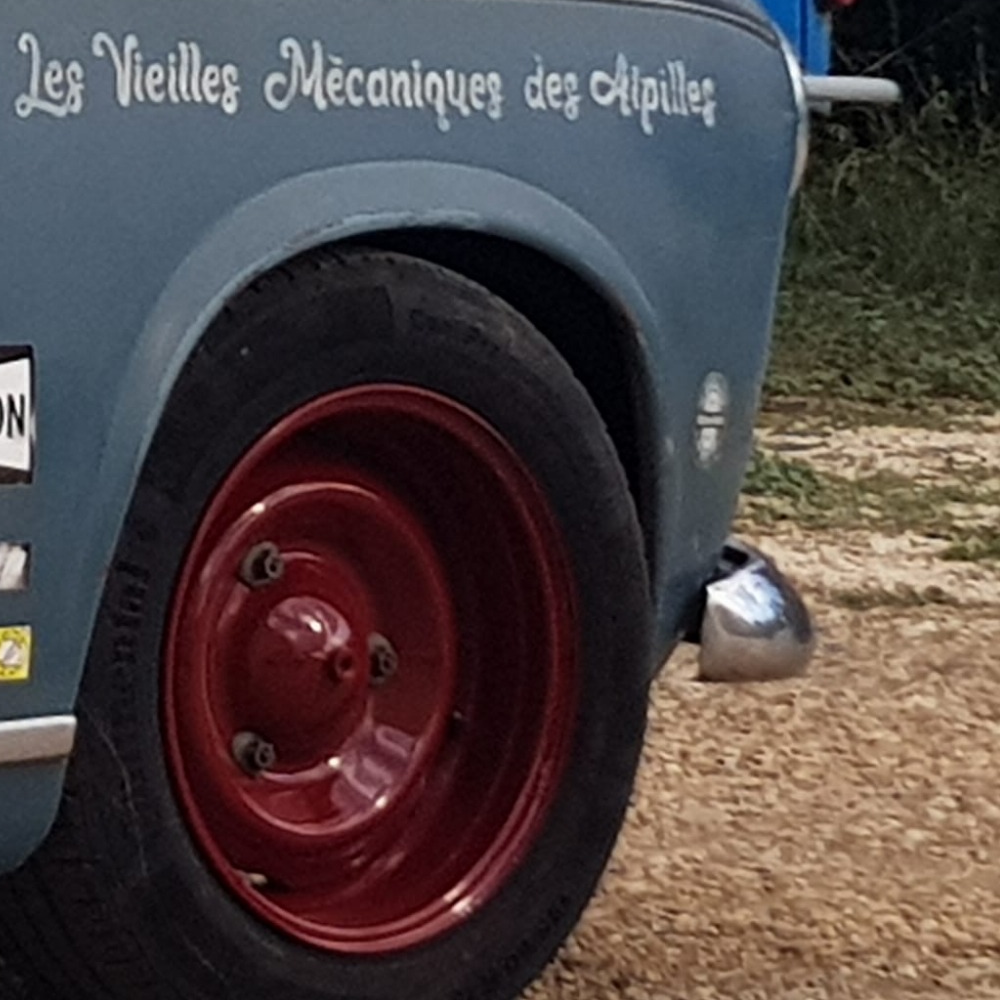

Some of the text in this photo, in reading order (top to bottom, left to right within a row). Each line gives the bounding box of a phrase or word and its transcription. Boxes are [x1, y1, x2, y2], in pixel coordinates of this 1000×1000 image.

[15, 32, 84, 118] Les
[92, 32, 241, 115] Vieilles
[524, 53, 581, 121] des
[590, 52, 717, 135] Alpilles
